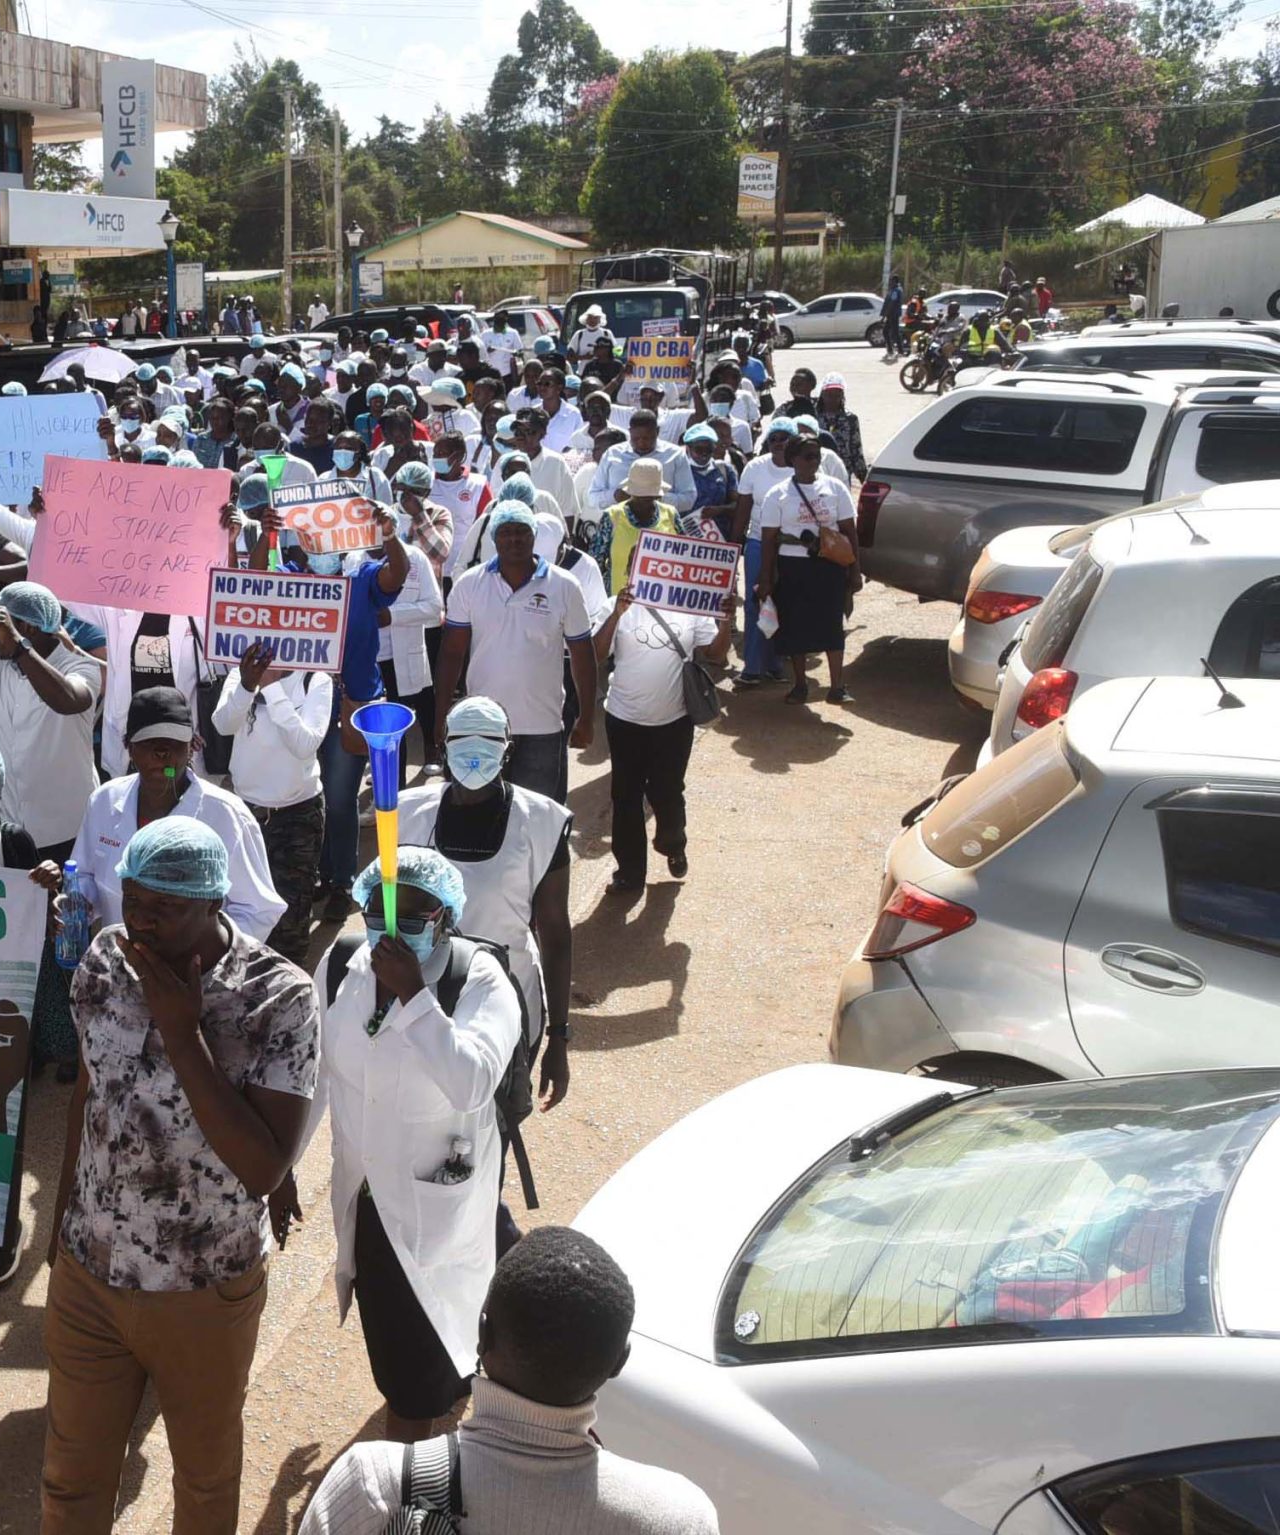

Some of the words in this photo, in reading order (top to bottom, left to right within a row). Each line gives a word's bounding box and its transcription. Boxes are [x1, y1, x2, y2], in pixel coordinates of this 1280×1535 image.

[119, 84, 136, 147] HFCB
[739, 183, 775, 191] SPACES
[96, 213, 125, 232] HFCB
[629, 340, 651, 357] NO
[656, 340, 689, 357] CBA
[88, 472, 144, 506] ARE
[151, 485, 208, 513] NOT
[273, 486, 312, 504] PUNDA
[53, 507, 91, 537] ON
[110, 516, 193, 546] STRIKE
[285, 497, 370, 531] COG
[331, 524, 377, 551] NOW
[642, 536, 659, 552] NO
[662, 541, 689, 556] PNP
[690, 544, 735, 564] LETTERS
[56, 540, 89, 565] THE
[102, 549, 152, 572] COG
[159, 553, 199, 574] ARE
[646, 560, 683, 578] FOR
[688, 567, 724, 585] UHC
[96, 576, 170, 600] STRIKE
[215, 576, 237, 594] NO
[241, 579, 273, 597] PNP
[277, 581, 342, 601] LETTERS
[635, 580, 662, 603] NO
[668, 586, 724, 612] WORK
[225, 605, 272, 625] FOR
[278, 609, 327, 628] UHC
[215, 632, 247, 659] NO
[254, 635, 331, 664] WORK
